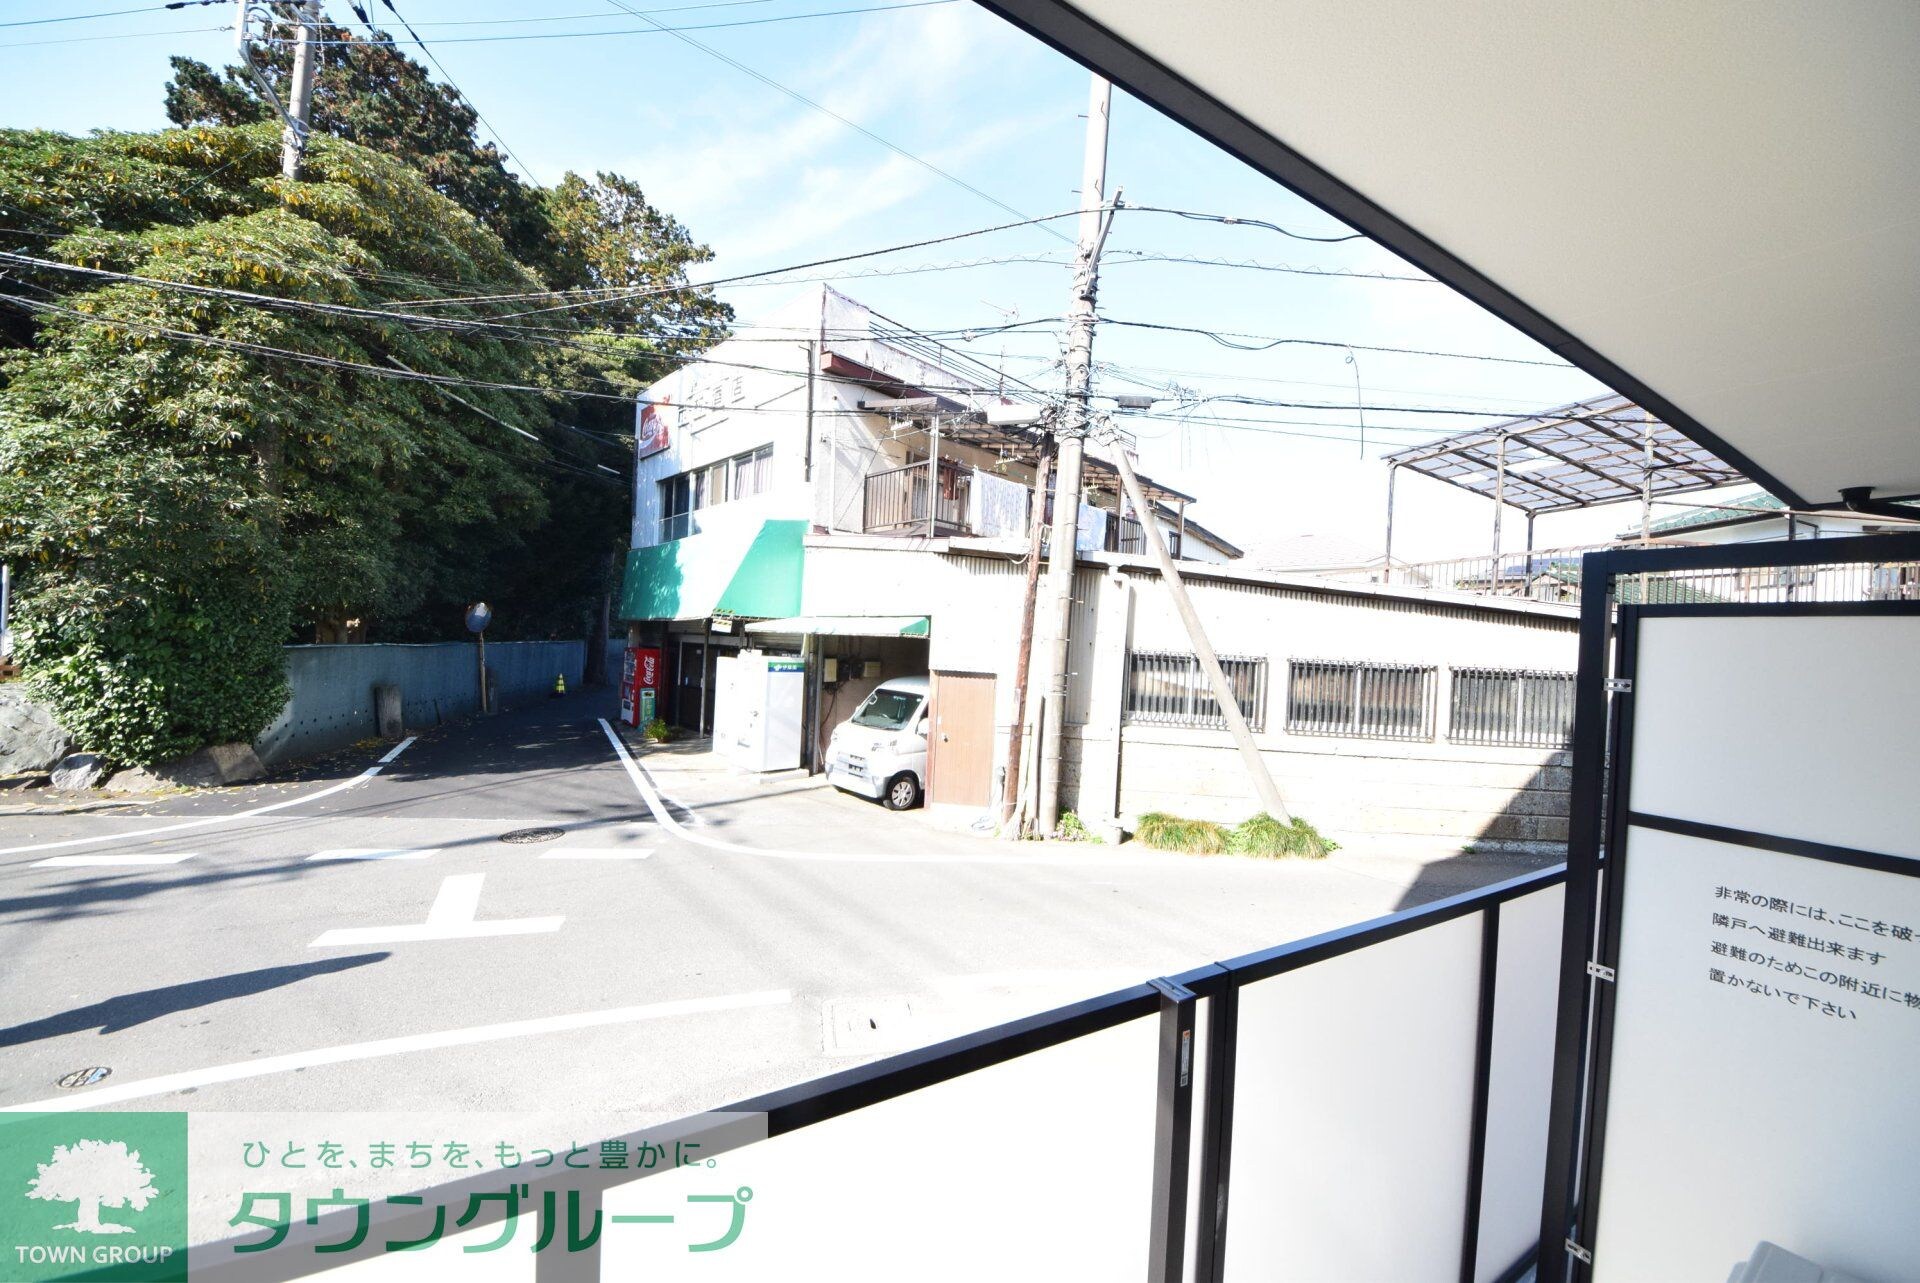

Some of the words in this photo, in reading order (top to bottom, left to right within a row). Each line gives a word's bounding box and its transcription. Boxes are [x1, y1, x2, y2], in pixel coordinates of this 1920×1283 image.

[1712, 912, 1887, 965] 隣戸へ避難出来ます
[1709, 968, 1857, 1020] 置かないで下さい
[1710, 940, 1920, 1011] 避難のためこの附近に物
